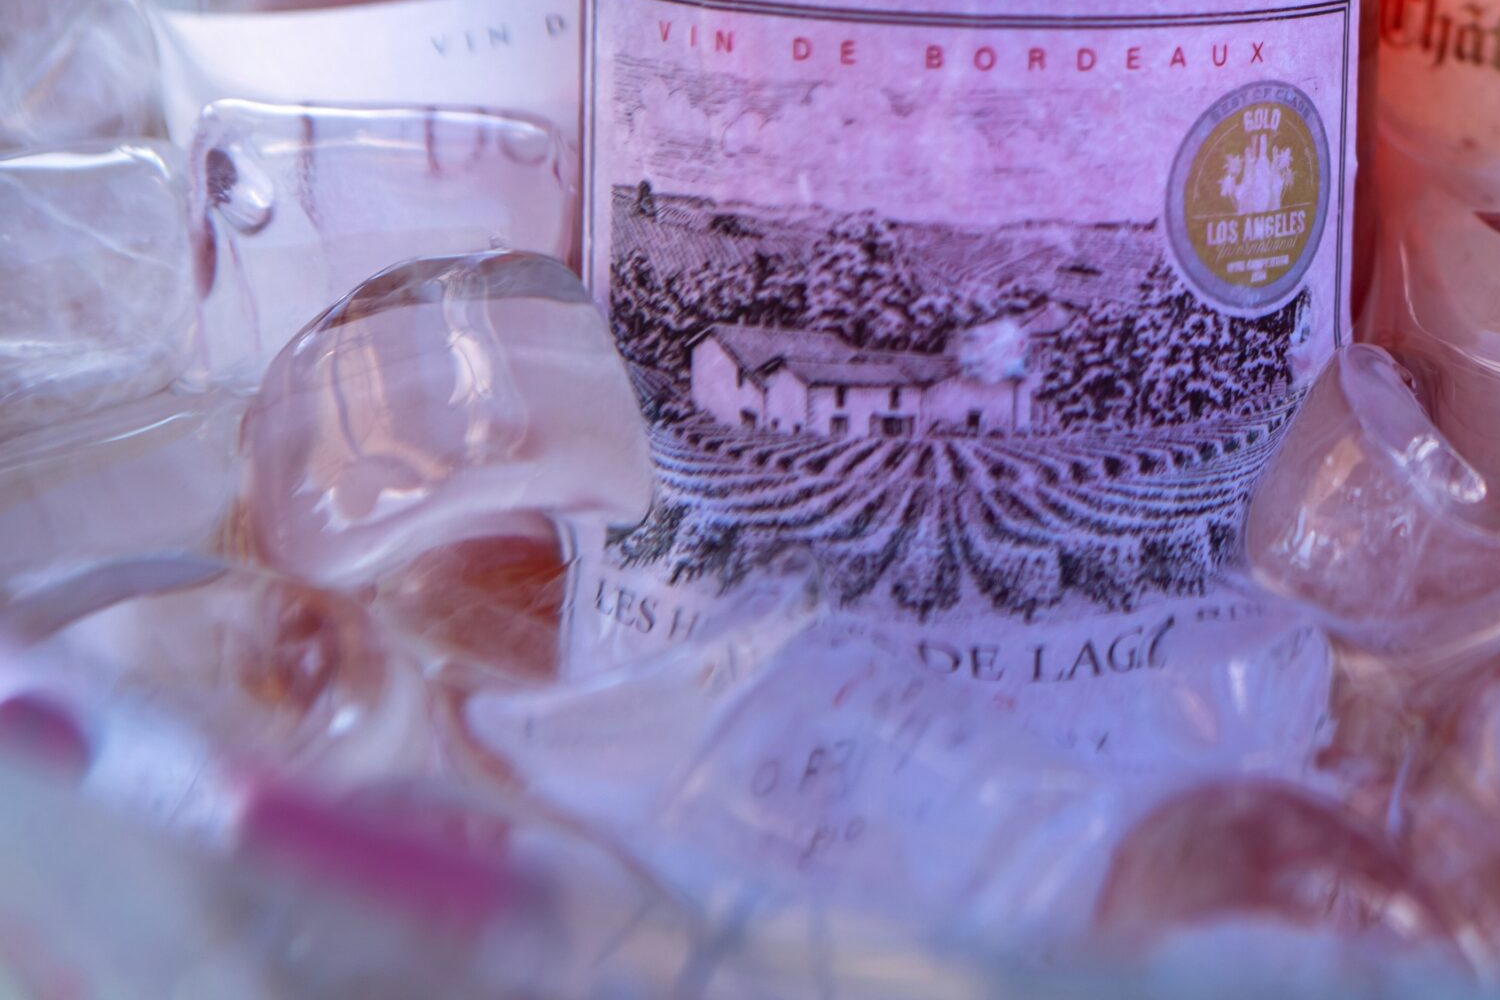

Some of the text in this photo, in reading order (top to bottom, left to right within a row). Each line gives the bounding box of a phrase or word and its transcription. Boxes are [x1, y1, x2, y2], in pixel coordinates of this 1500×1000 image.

[430, 22, 511, 60] VIN
[657, 20, 1265, 73] VIN DE BORDEAUX
[1243, 107, 1282, 132] GOLD
[1207, 208, 1307, 246] LOS ANGELES
[595, 579, 655, 634] LES
[916, 638, 1004, 683] DE
